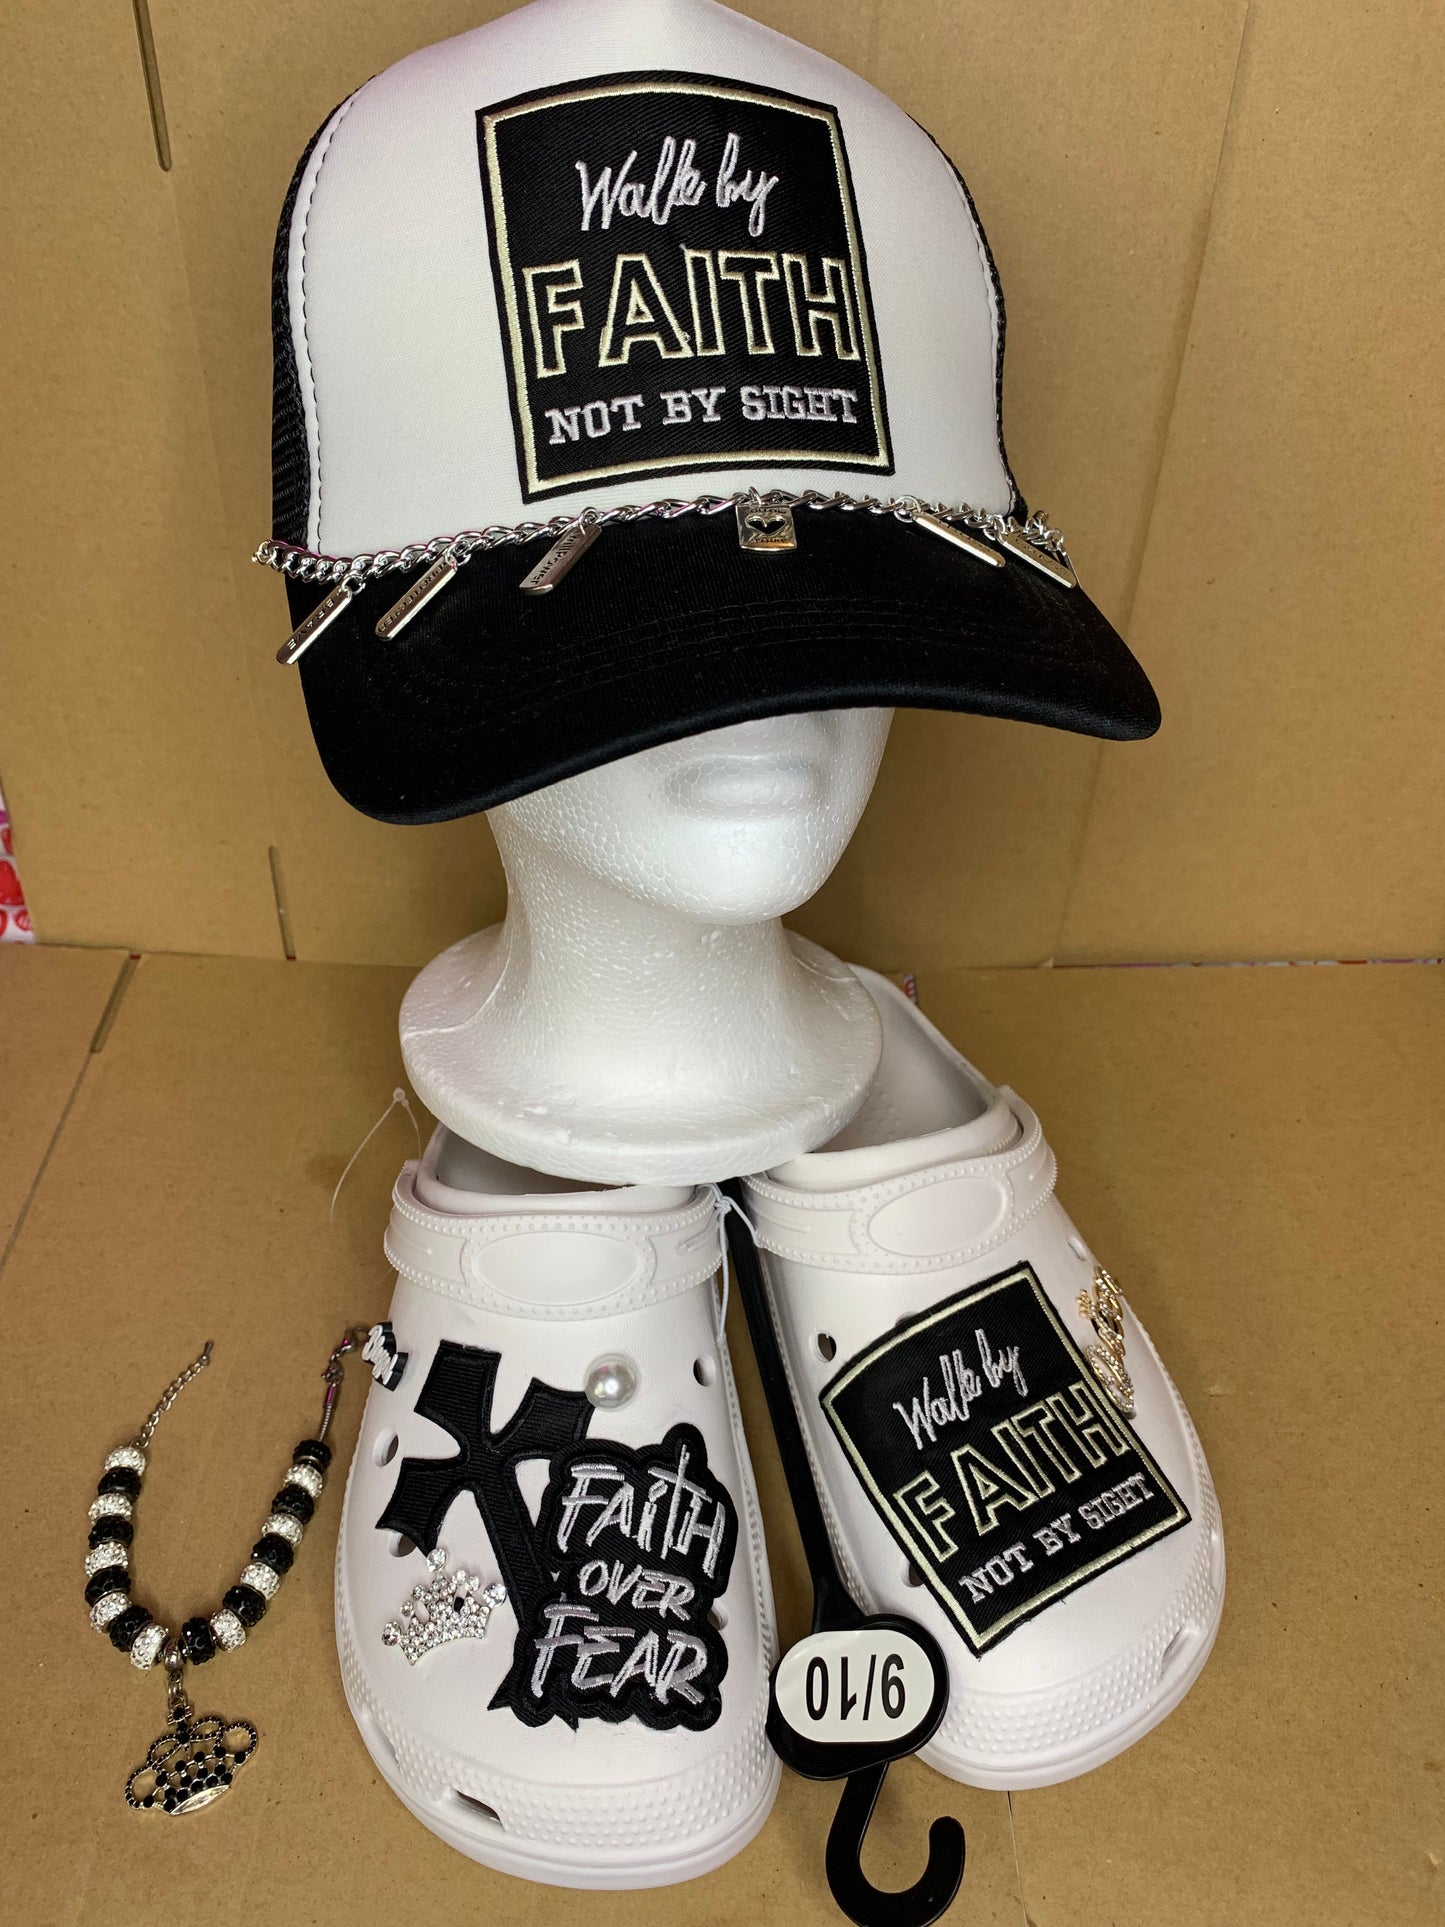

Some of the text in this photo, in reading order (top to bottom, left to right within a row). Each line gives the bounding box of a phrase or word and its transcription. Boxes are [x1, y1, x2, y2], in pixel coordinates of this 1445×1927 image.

[575, 132, 779, 237] Walk by
[522, 248, 861, 379] FAITH
[545, 384, 859, 445] NOT BY SIGHT
[286, 598, 335, 650] BRAVE
[893, 1328, 1029, 1450] Walk by
[893, 1380, 1131, 1563] FAITH
[578, 1560, 695, 1621] OVER
[959, 1473, 1156, 1604] NOT BY SIGHT
[531, 1601, 708, 1705] FEAR
[805, 1653, 906, 1721] 9/10
